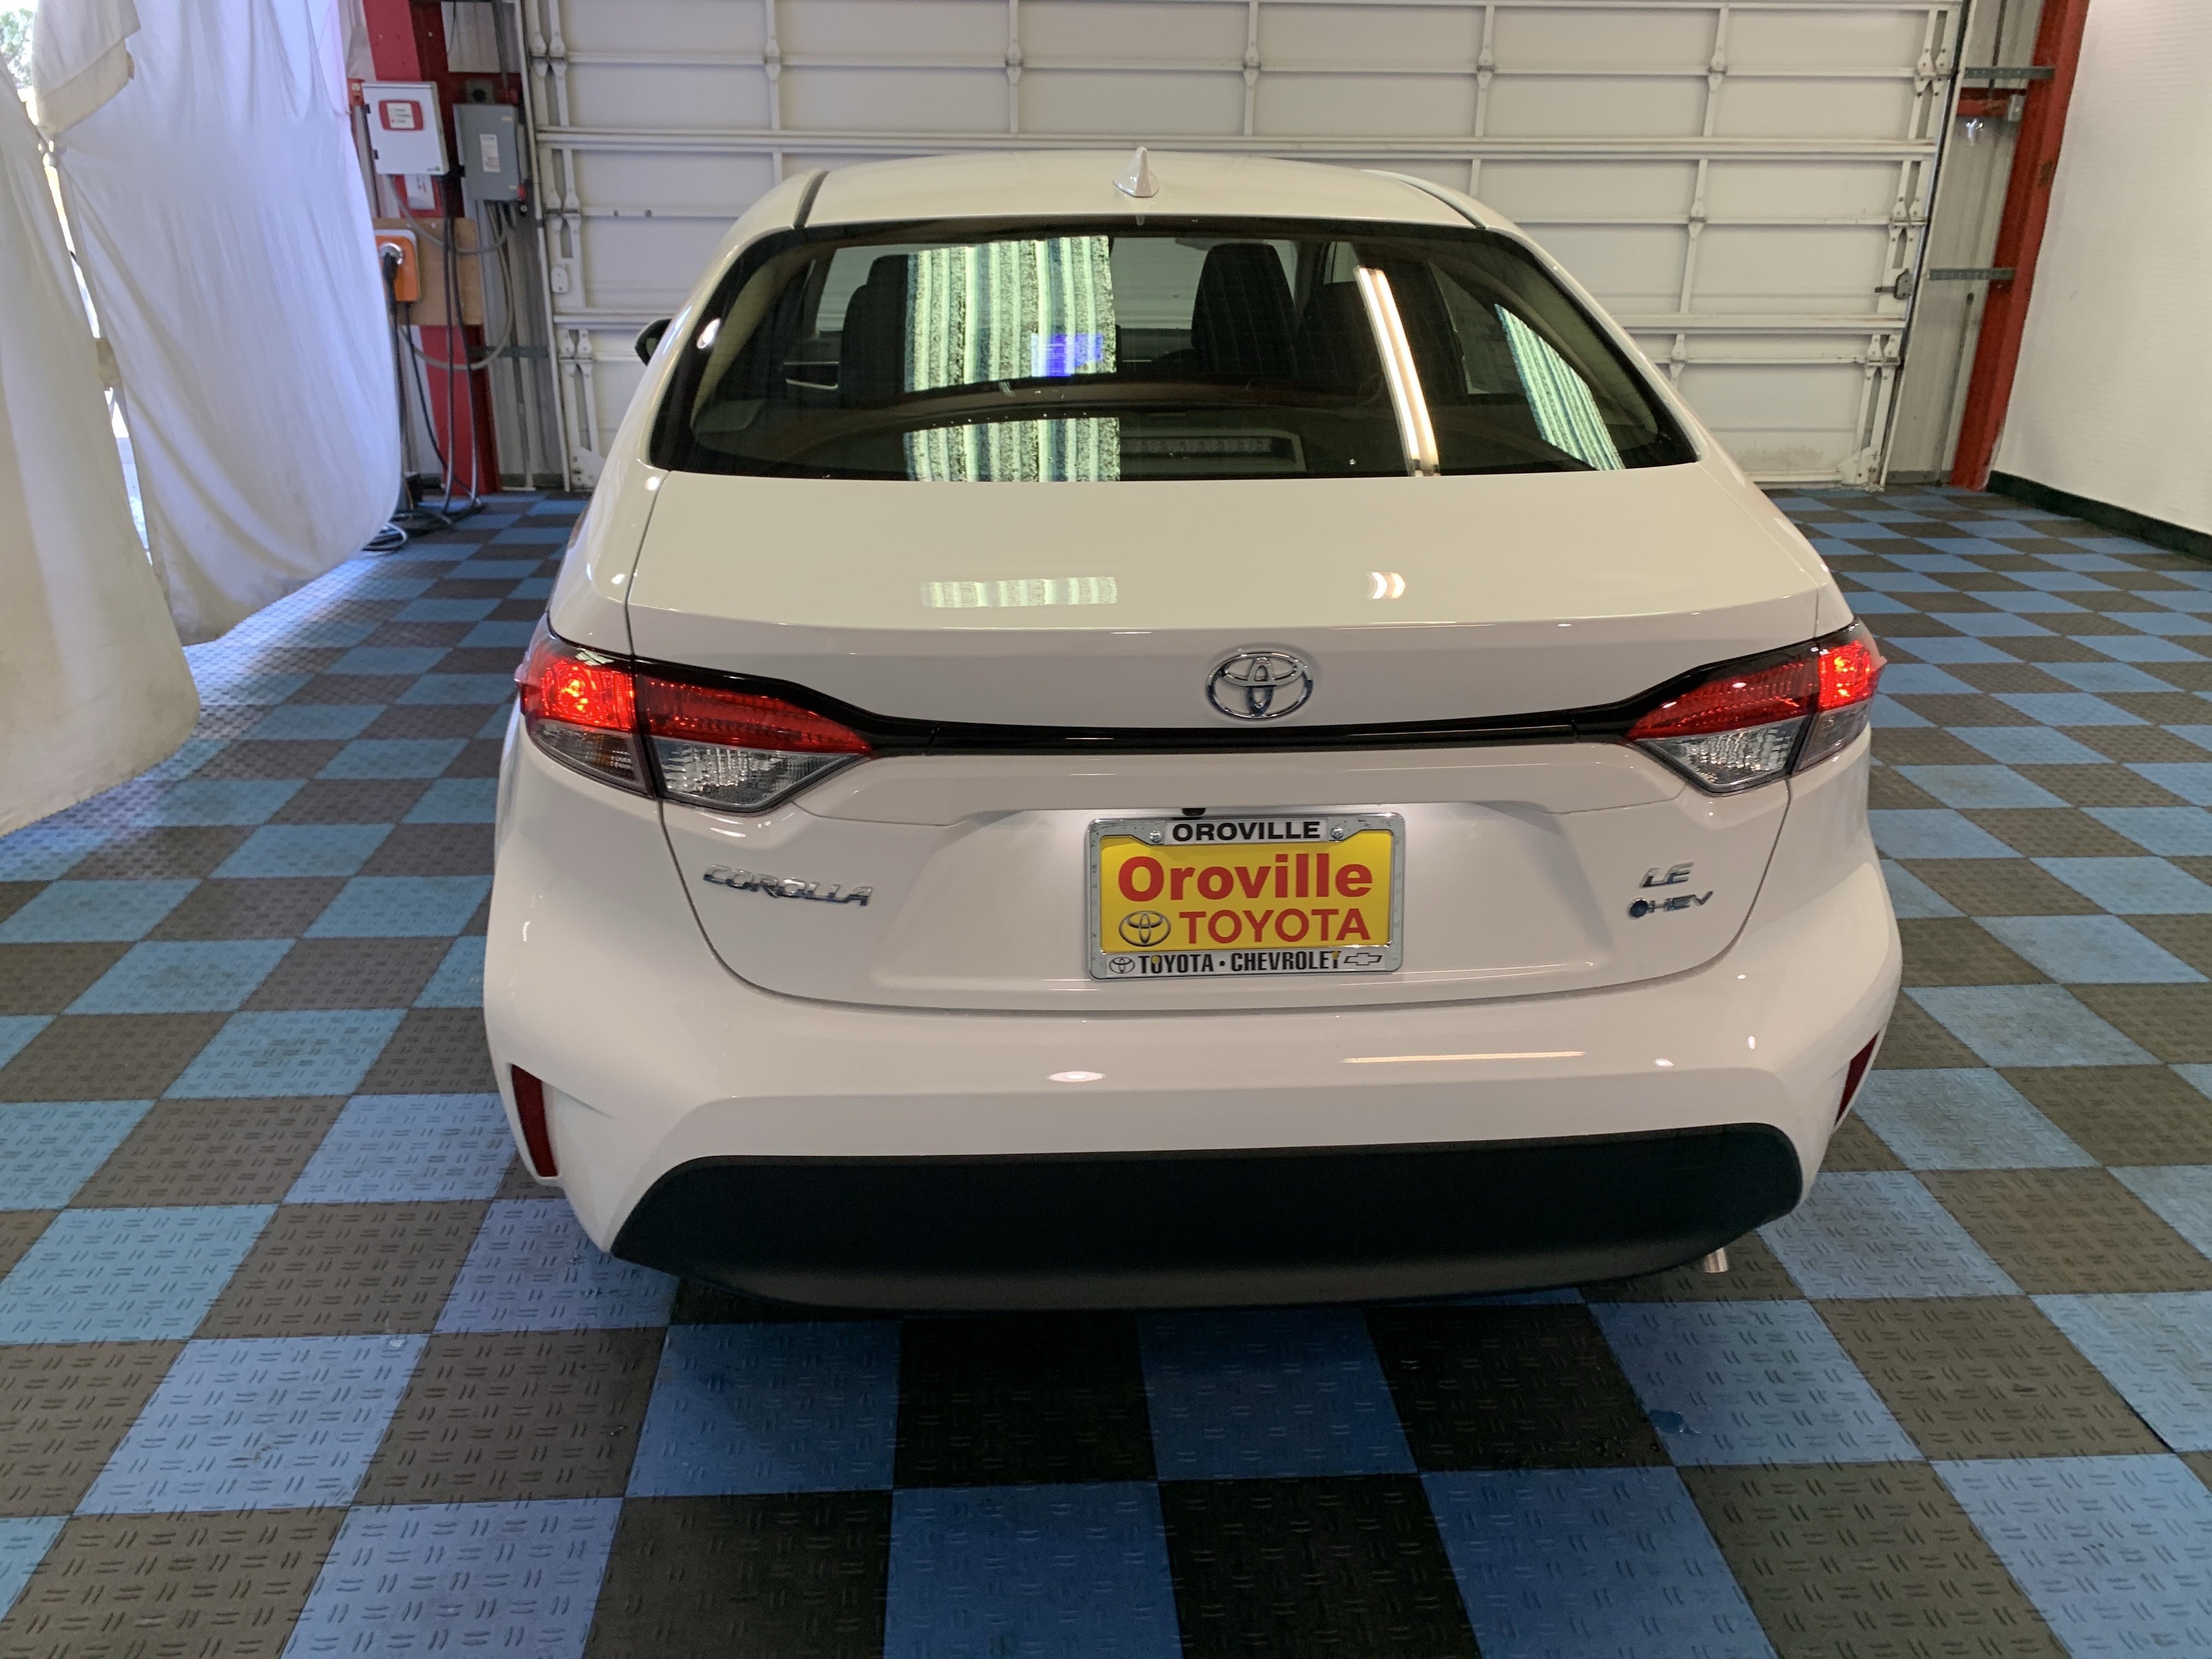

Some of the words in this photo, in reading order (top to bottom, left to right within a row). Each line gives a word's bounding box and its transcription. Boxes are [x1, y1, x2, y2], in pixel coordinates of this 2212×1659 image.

[1172, 821, 1321, 841] OROVILLE
[703, 864, 873, 906] COROLLA
[1118, 853, 1373, 902] Oroville
[1639, 861, 1695, 888] LE
[1179, 908, 1371, 944] TOYOTA
[1138, 953, 1214, 974] TOYOTA
